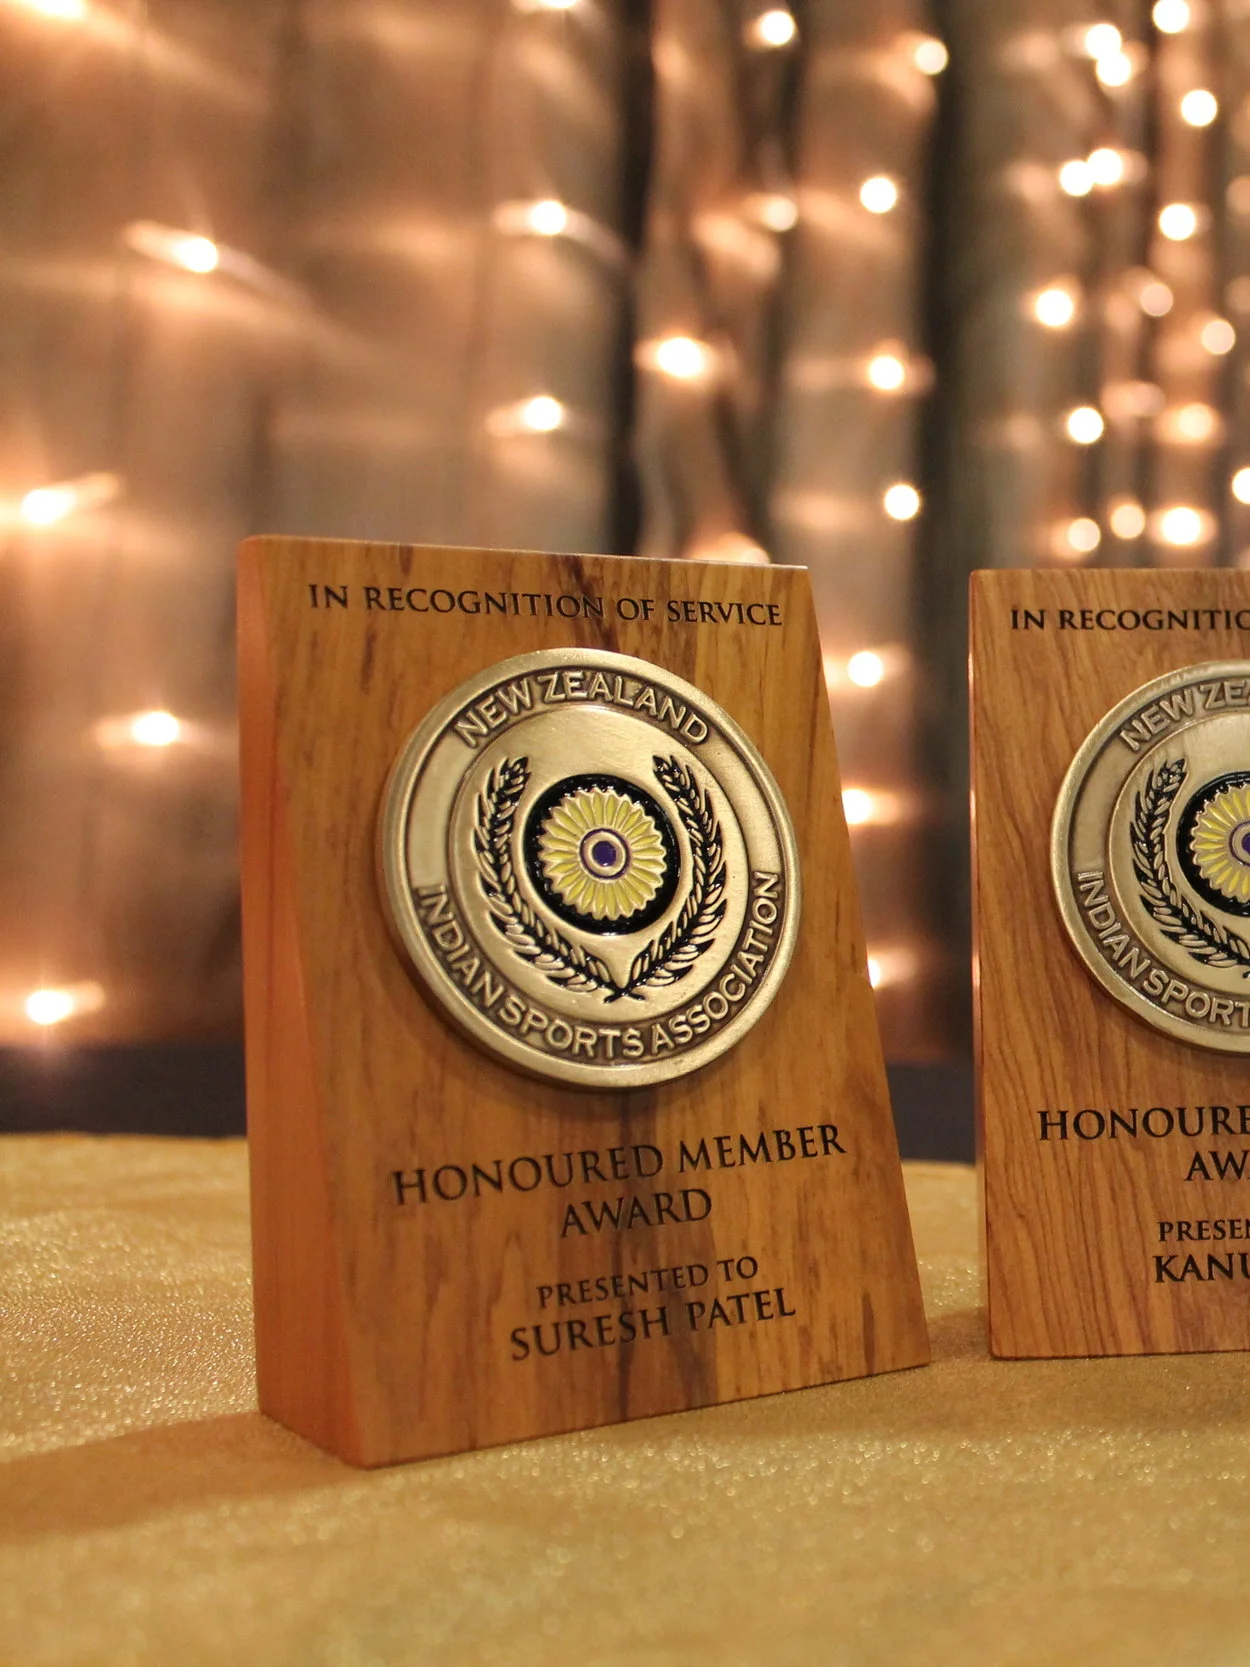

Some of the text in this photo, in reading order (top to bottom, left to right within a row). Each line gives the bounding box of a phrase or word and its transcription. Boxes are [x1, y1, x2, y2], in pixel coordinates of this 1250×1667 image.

[309, 584, 783, 627] IN RECOGNITION OF SERVICE
[1010, 608, 1046, 630] IN
[454, 671, 711, 748] NEW ZEALAND
[1119, 690, 1194, 752] NEW
[1077, 871, 1153, 980] INDIAN
[416, 872, 779, 1059] INDIAN SPORTS ASSOCIATION
[393, 1124, 847, 1205] HONOURED MEMBER
[560, 1188, 712, 1238] AWARD
[537, 1255, 758, 1309] PRESENTED TO
[510, 1288, 796, 1361] SURESH PATEL
